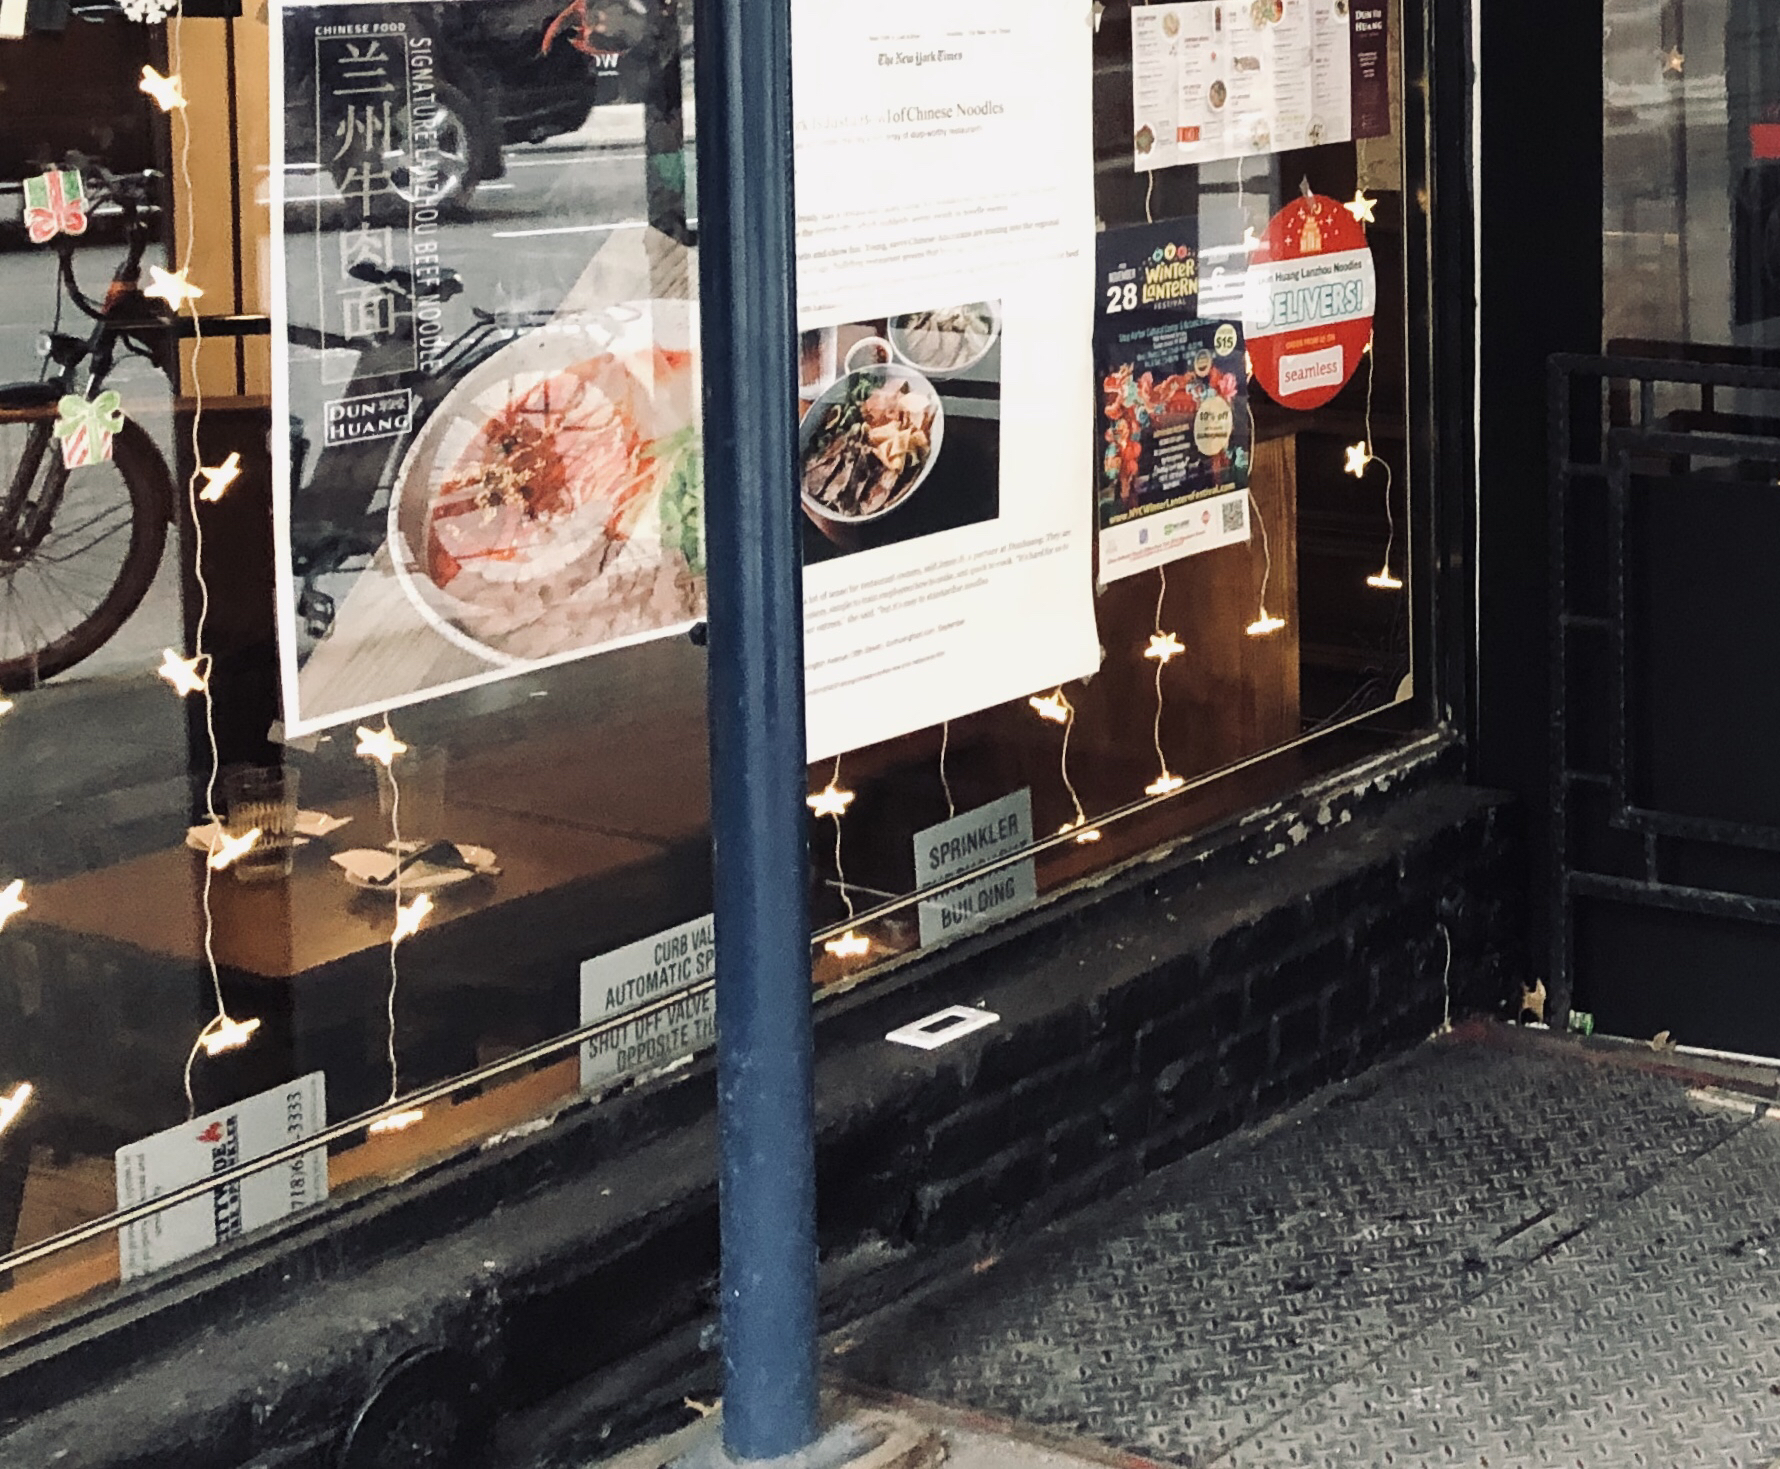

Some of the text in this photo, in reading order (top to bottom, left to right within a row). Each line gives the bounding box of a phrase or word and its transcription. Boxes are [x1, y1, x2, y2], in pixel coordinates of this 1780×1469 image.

[315, 22, 406, 36] CHINESE FOOD
[878, 53, 894, 66] The
[937, 49, 963, 62] Times
[410, 37, 438, 141] SIGNATURE
[893, 107, 905, 123] of
[907, 104, 953, 122] Chinese
[957, 100, 1004, 116] Noodles
[415, 241, 440, 286] BEEF
[1275, 270, 1300, 284] Huang
[1301, 265, 1332, 279] Lanzhou
[1334, 260, 1363, 273] Noodles
[1106, 283, 1137, 314] 28
[1153, 298, 1187, 310] FESTIVAL
[1256, 280, 1363, 330] DELIVERS!
[417, 295, 444, 371] NOODLE
[1215, 336, 1234, 349] $15
[1284, 360, 1338, 383] seamless
[329, 402, 375, 421] DUN
[330, 414, 409, 440] HUANG
[929, 813, 1019, 870] SPRINKLER
[940, 877, 1015, 929] BUILDING
[654, 933, 688, 966] CURB
[605, 956, 692, 1011] AUTOMATIC
[588, 1025, 628, 1060] SHUT
[667, 990, 710, 1026] VALVE
[617, 1027, 688, 1073] OPPOSITE
